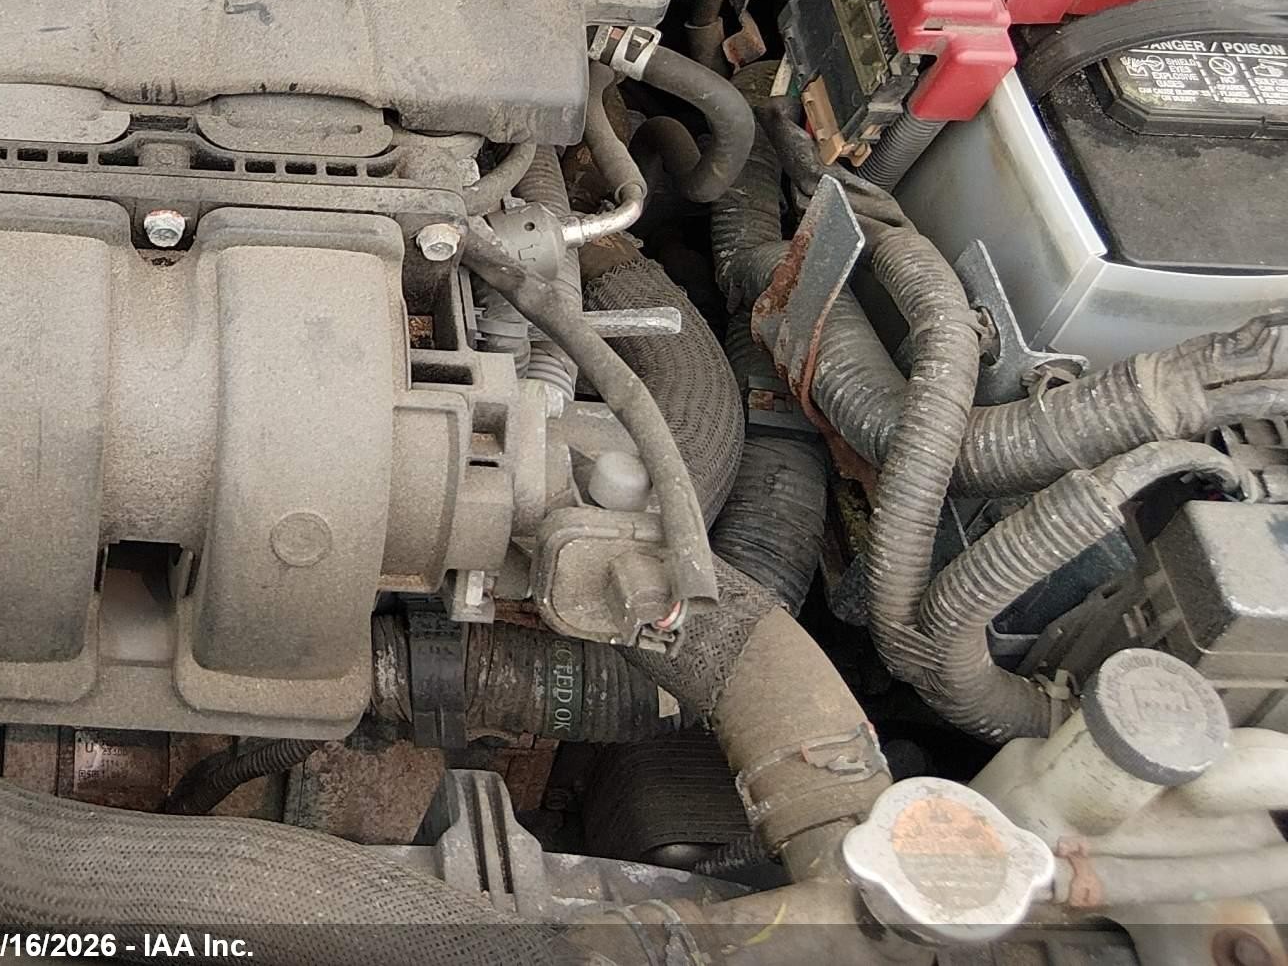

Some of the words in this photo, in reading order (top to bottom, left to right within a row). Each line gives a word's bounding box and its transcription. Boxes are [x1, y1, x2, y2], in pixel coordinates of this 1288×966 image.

[1142, 39, 1207, 52] ANGER
[1222, 41, 1287, 55] POISON
[1165, 57, 1197, 67] SHIELD
[1169, 65, 1192, 73] EYES
[1152, 72, 1199, 81] EXPLOSIVE
[553, 708, 572, 731] OK
